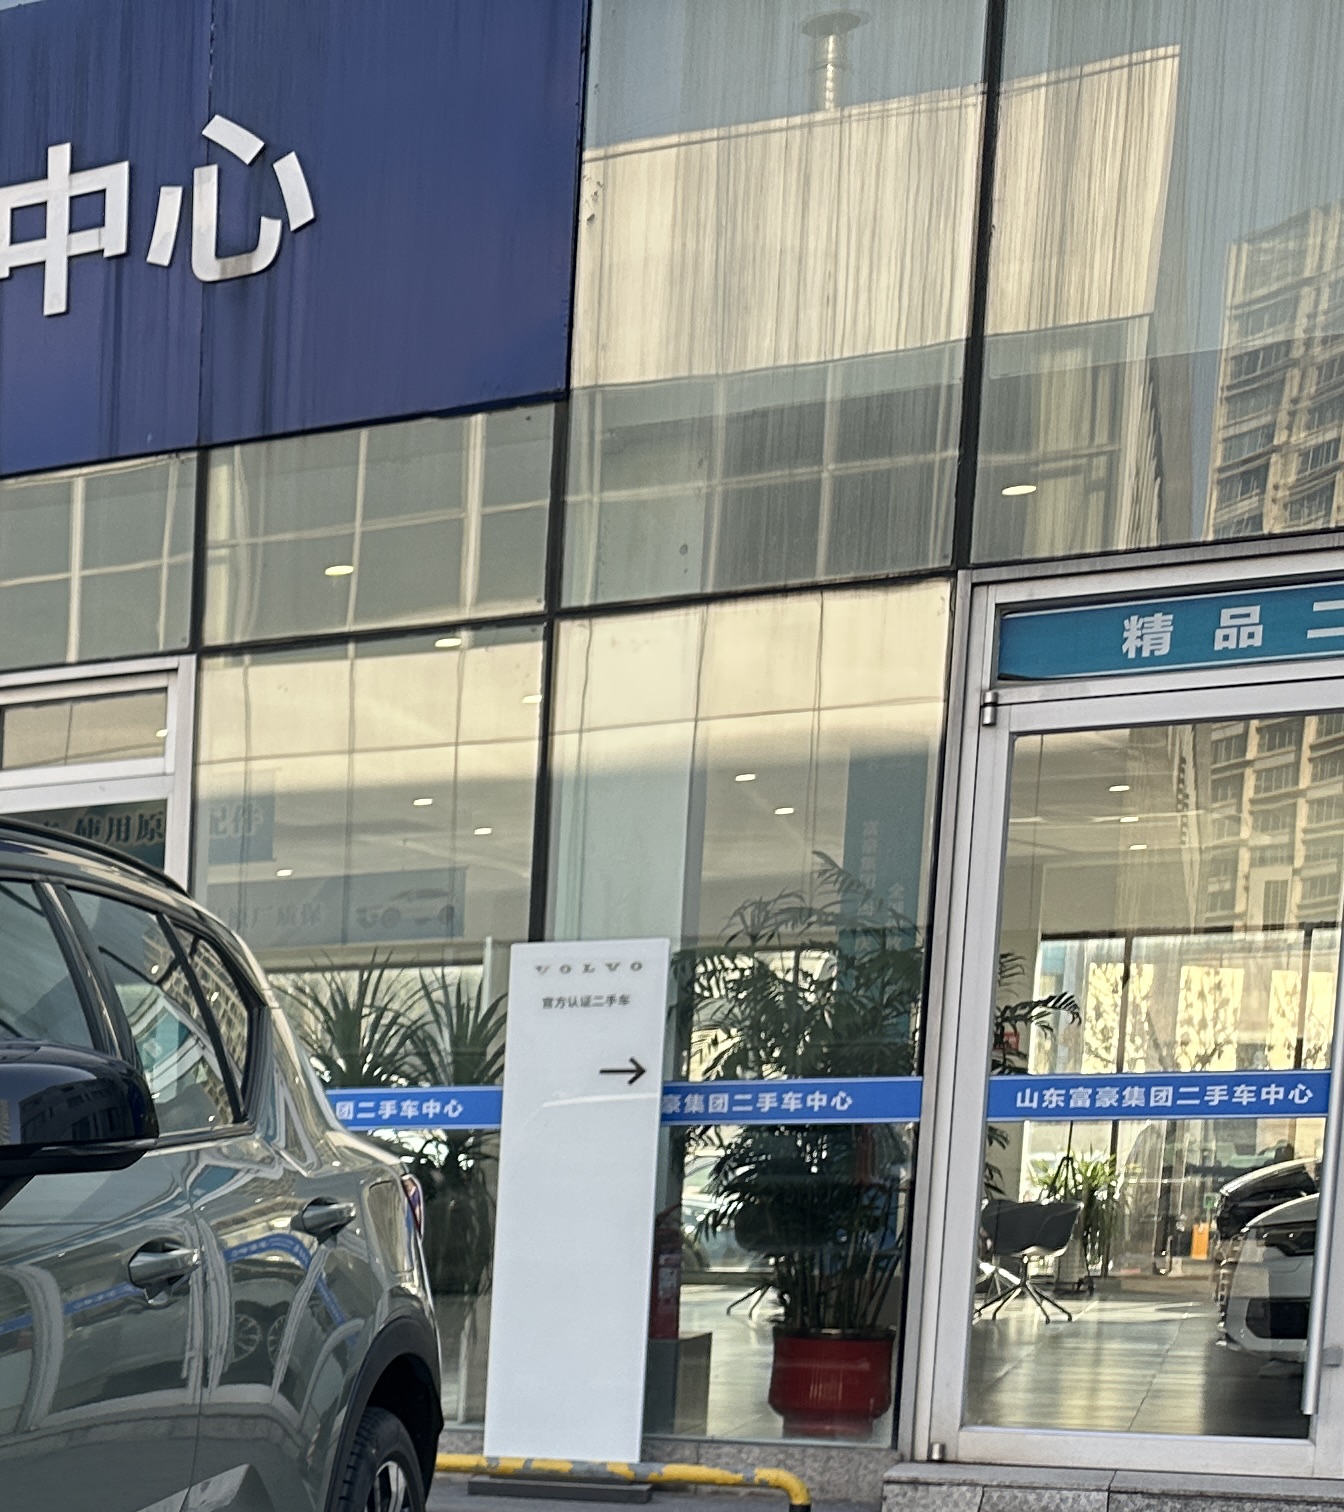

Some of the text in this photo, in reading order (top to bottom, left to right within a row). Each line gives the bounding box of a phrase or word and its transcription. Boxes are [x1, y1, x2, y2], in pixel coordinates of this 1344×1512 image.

[535, 961, 643, 975] VOLVO
[542, 994, 632, 1009] 官方认证二手车
[1016, 1083, 1313, 1109] 山东富豪集团二手车中心
[335, 1098, 464, 1120] 团二手车中心
